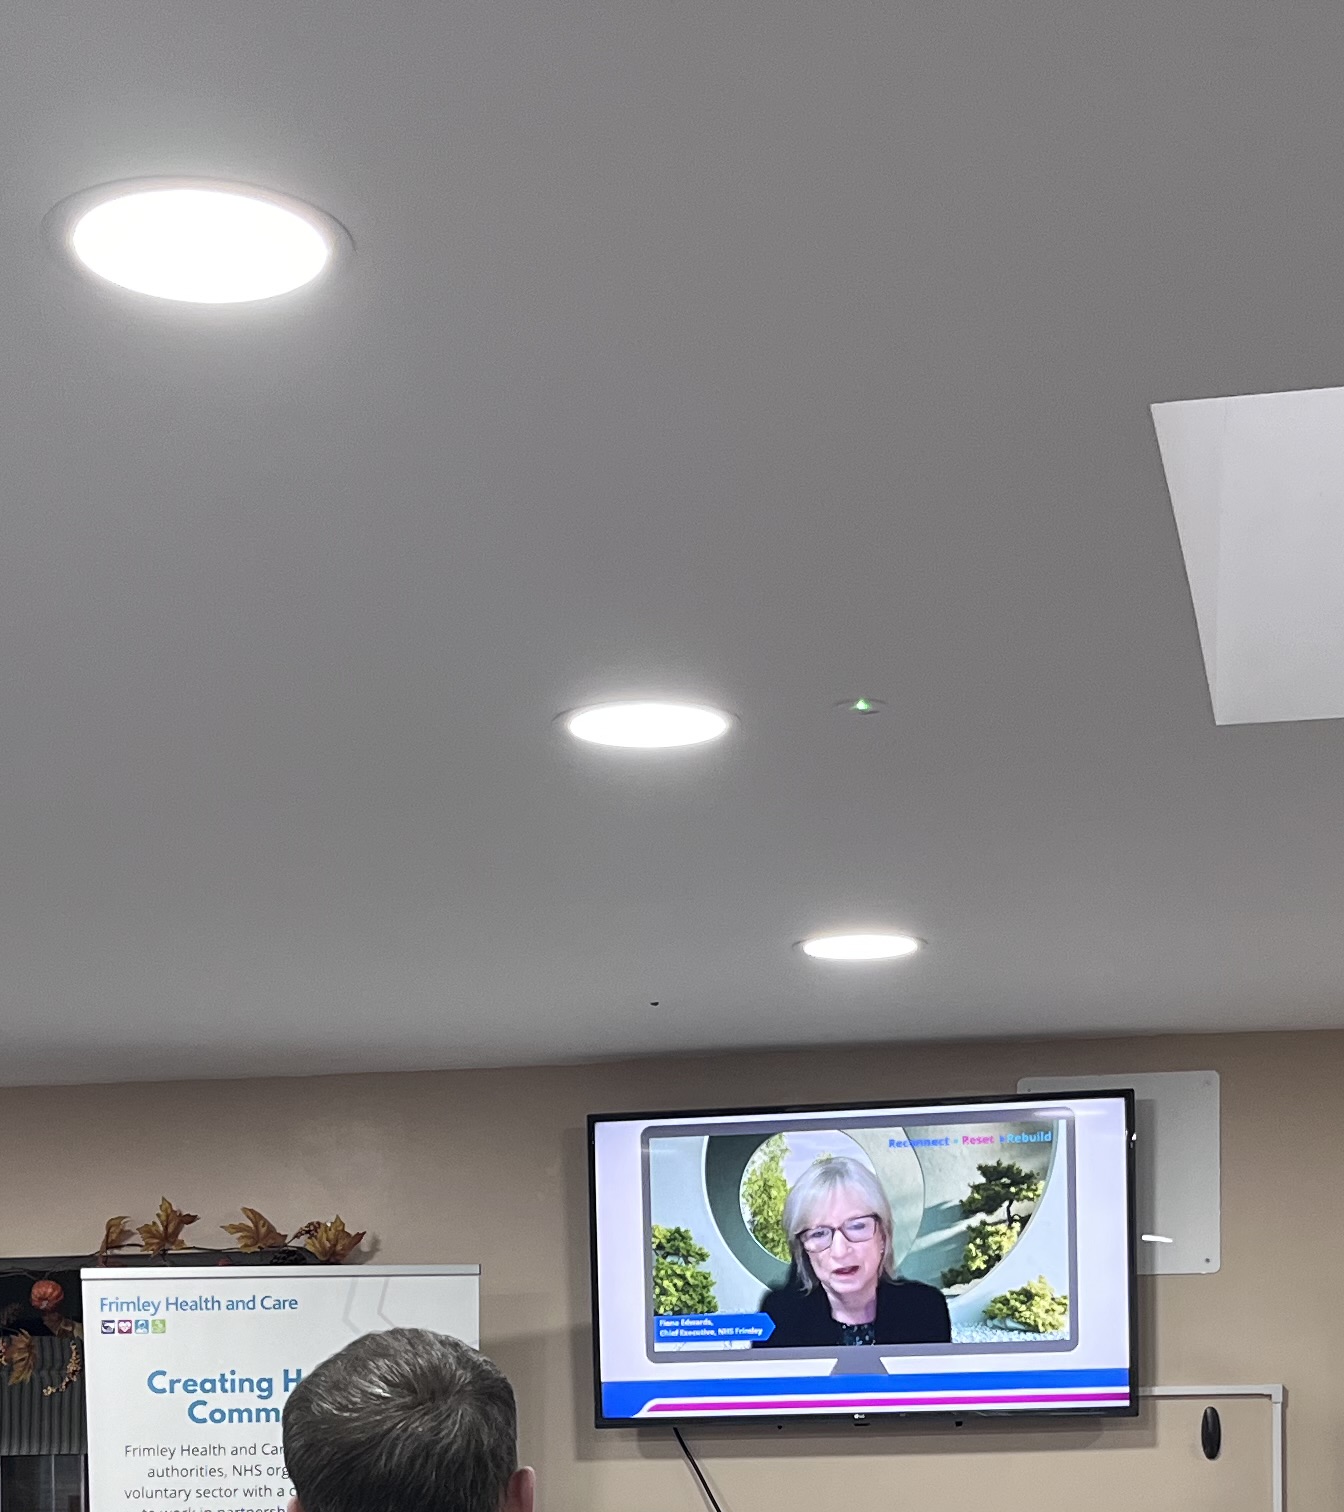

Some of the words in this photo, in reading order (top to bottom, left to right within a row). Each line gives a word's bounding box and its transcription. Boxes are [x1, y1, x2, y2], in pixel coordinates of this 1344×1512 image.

[889, 1137, 949, 1147] Reconnect
[962, 1136, 994, 1144] Reset
[1007, 1131, 1052, 1142] Rebuild
[100, 1296, 161, 1316] Frimley
[166, 1296, 221, 1312] Health
[226, 1295, 255, 1310] and
[261, 1295, 298, 1310] Care
[735, 1327, 763, 1336] Frimley
[147, 1370, 273, 1399] Creating
[125, 1445, 176, 1460] Frimley
[180, 1444, 226, 1456] Health
[230, 1443, 256, 1456] and
[147, 1465, 227, 1479] authorities,
[233, 1465, 262, 1476] NHS
[124, 1486, 191, 1502] voluntary
[196, 1488, 238, 1498] sector
[243, 1485, 272, 1497] with
[277, 1488, 284, 1497] a
